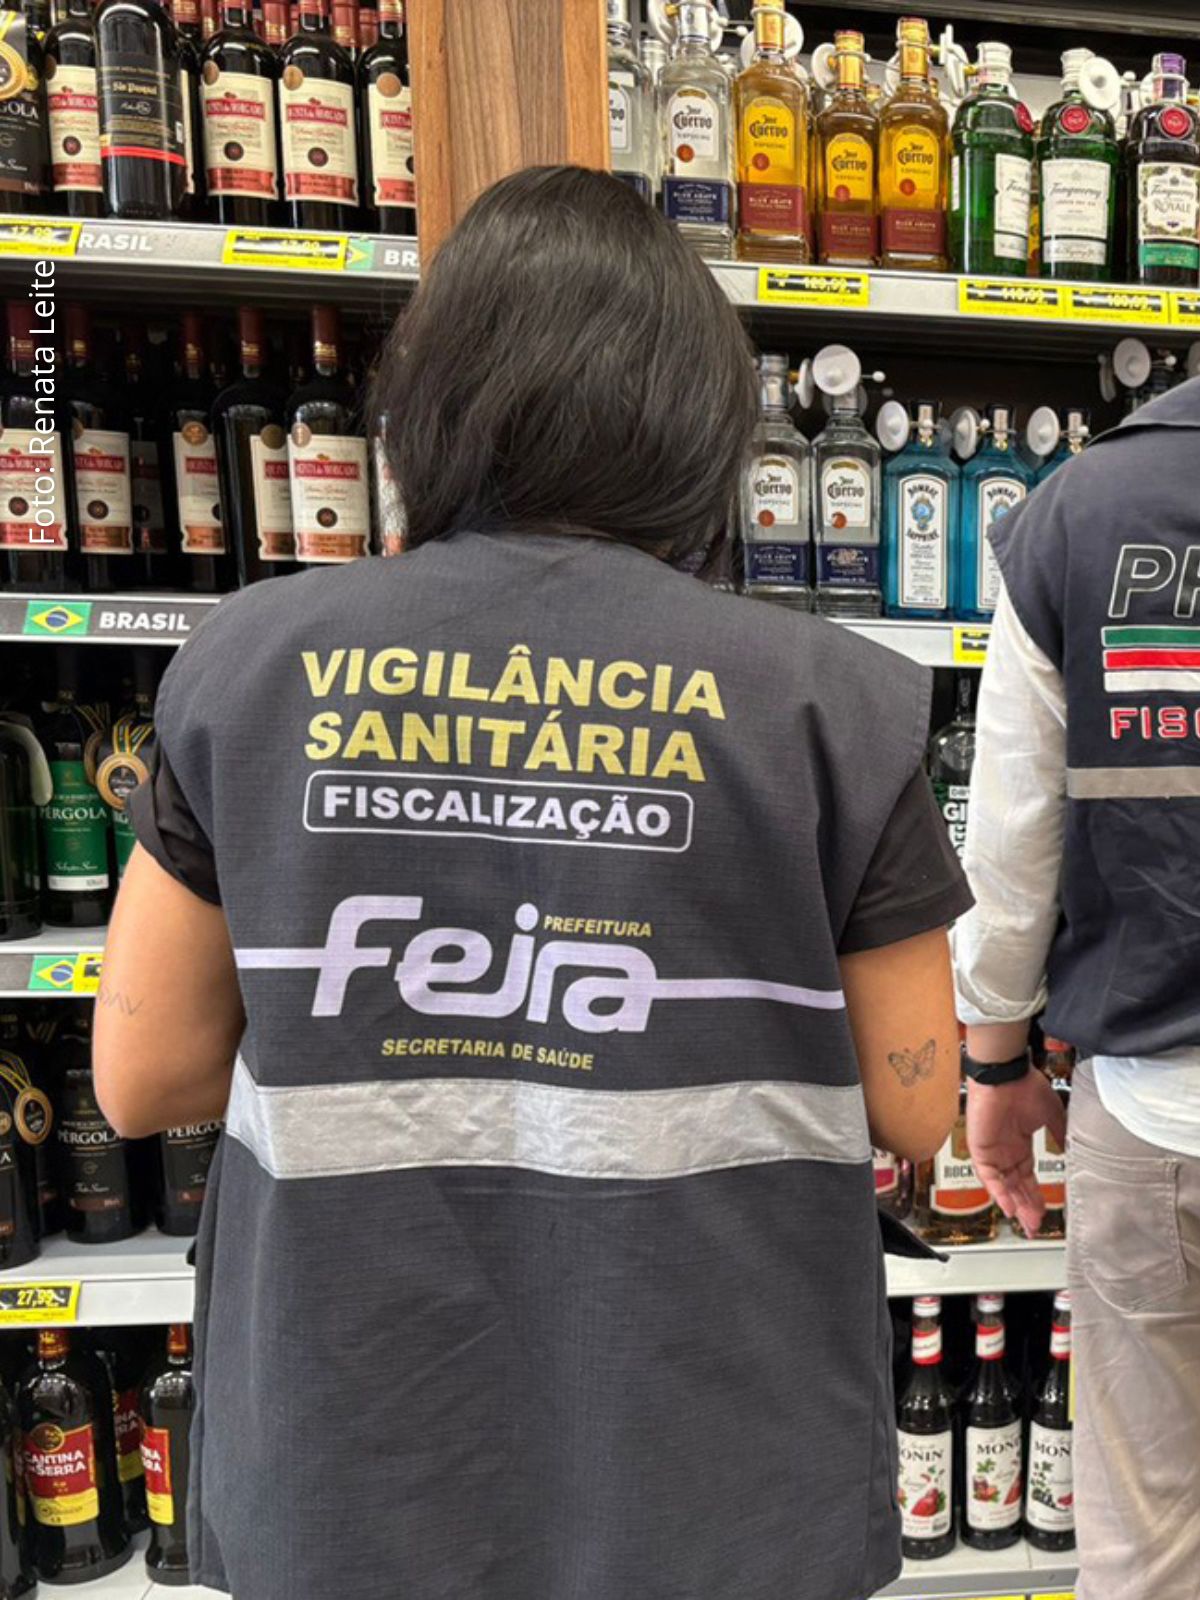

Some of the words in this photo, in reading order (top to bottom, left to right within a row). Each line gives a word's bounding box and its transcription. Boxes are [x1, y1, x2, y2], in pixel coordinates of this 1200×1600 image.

[673, 110, 713, 130] Cuervo
[749, 120, 788, 139] Cuervo
[79, 233, 153, 251] RASIL
[754, 482, 793, 497] Cuervo
[827, 484, 865, 499] Cuervo
[99, 611, 191, 632] BRASIL
[301, 644, 726, 720] VIGILÂNCIA
[304, 710, 706, 783] SANITÁRIA
[323, 785, 671, 840] FISCALIZAÇÃO
[544, 914, 652, 938] PREFEITURA
[381, 1037, 506, 1058] SECRETARIA
[511, 1042, 533, 1062] DE
[537, 1047, 595, 1071] SAÚDE
[167, 1120, 220, 1138] PERGO
[901, 1449, 944, 1462] ONIN
[976, 1440, 1012, 1455] MON
[1035, 1440, 1071, 1457] MON
[38, 1462, 87, 1477] SERRA
